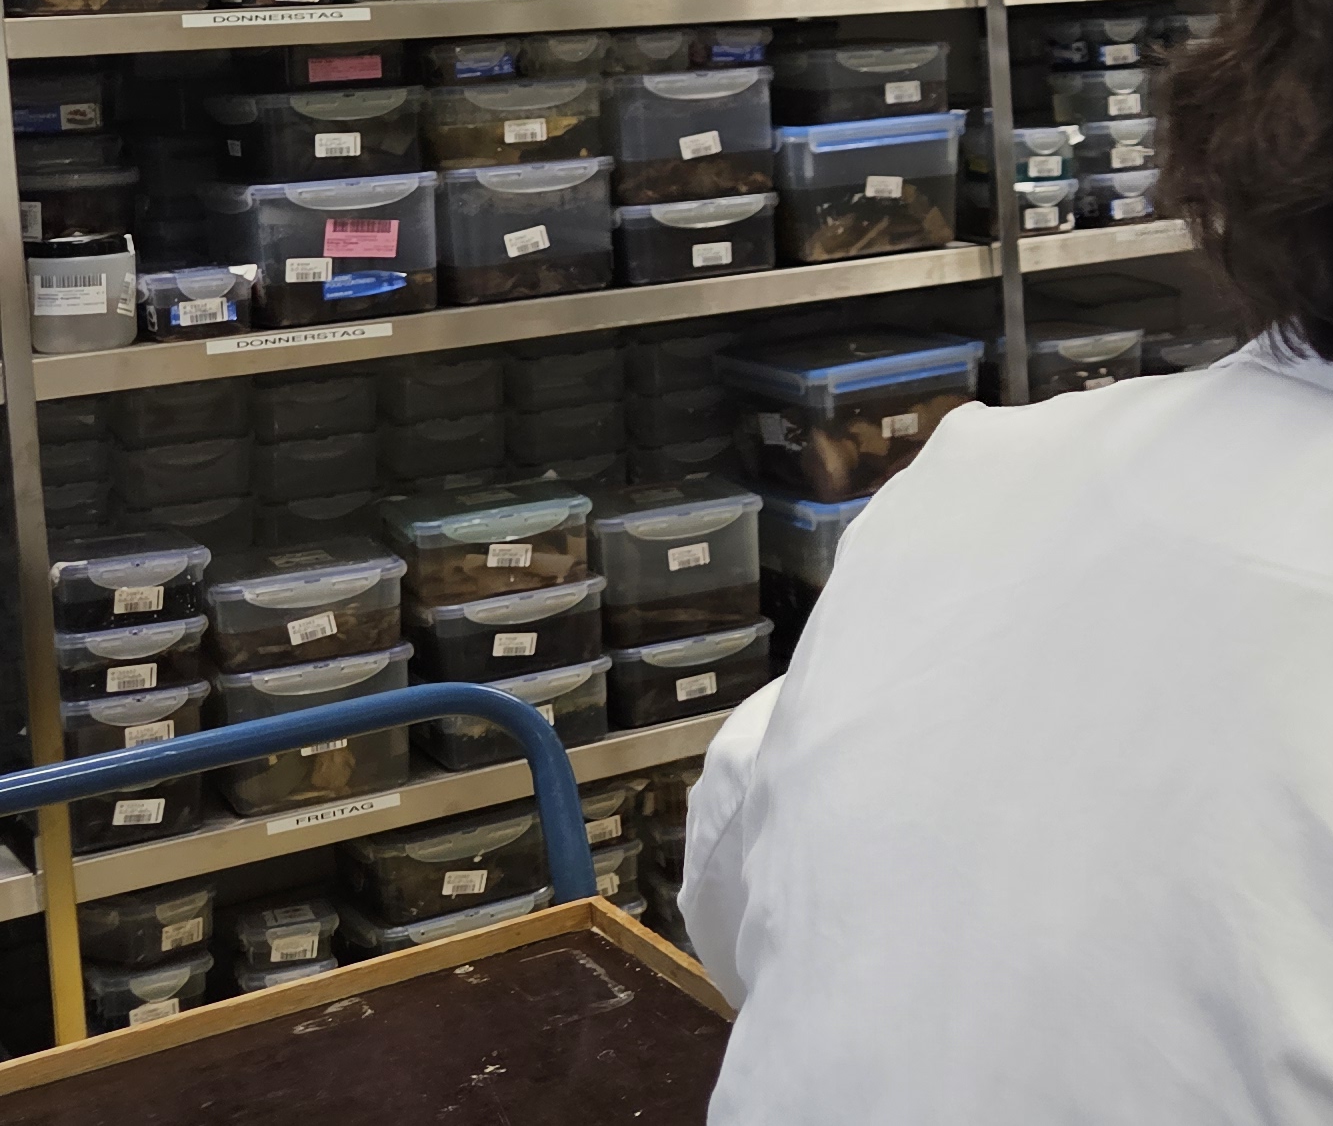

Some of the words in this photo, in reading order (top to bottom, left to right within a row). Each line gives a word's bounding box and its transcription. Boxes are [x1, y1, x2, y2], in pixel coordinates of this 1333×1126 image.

[212, 10, 344, 24] DONNERSTAG
[236, 328, 366, 349] DONNERSTAG
[295, 801, 374, 826] FREITAG
